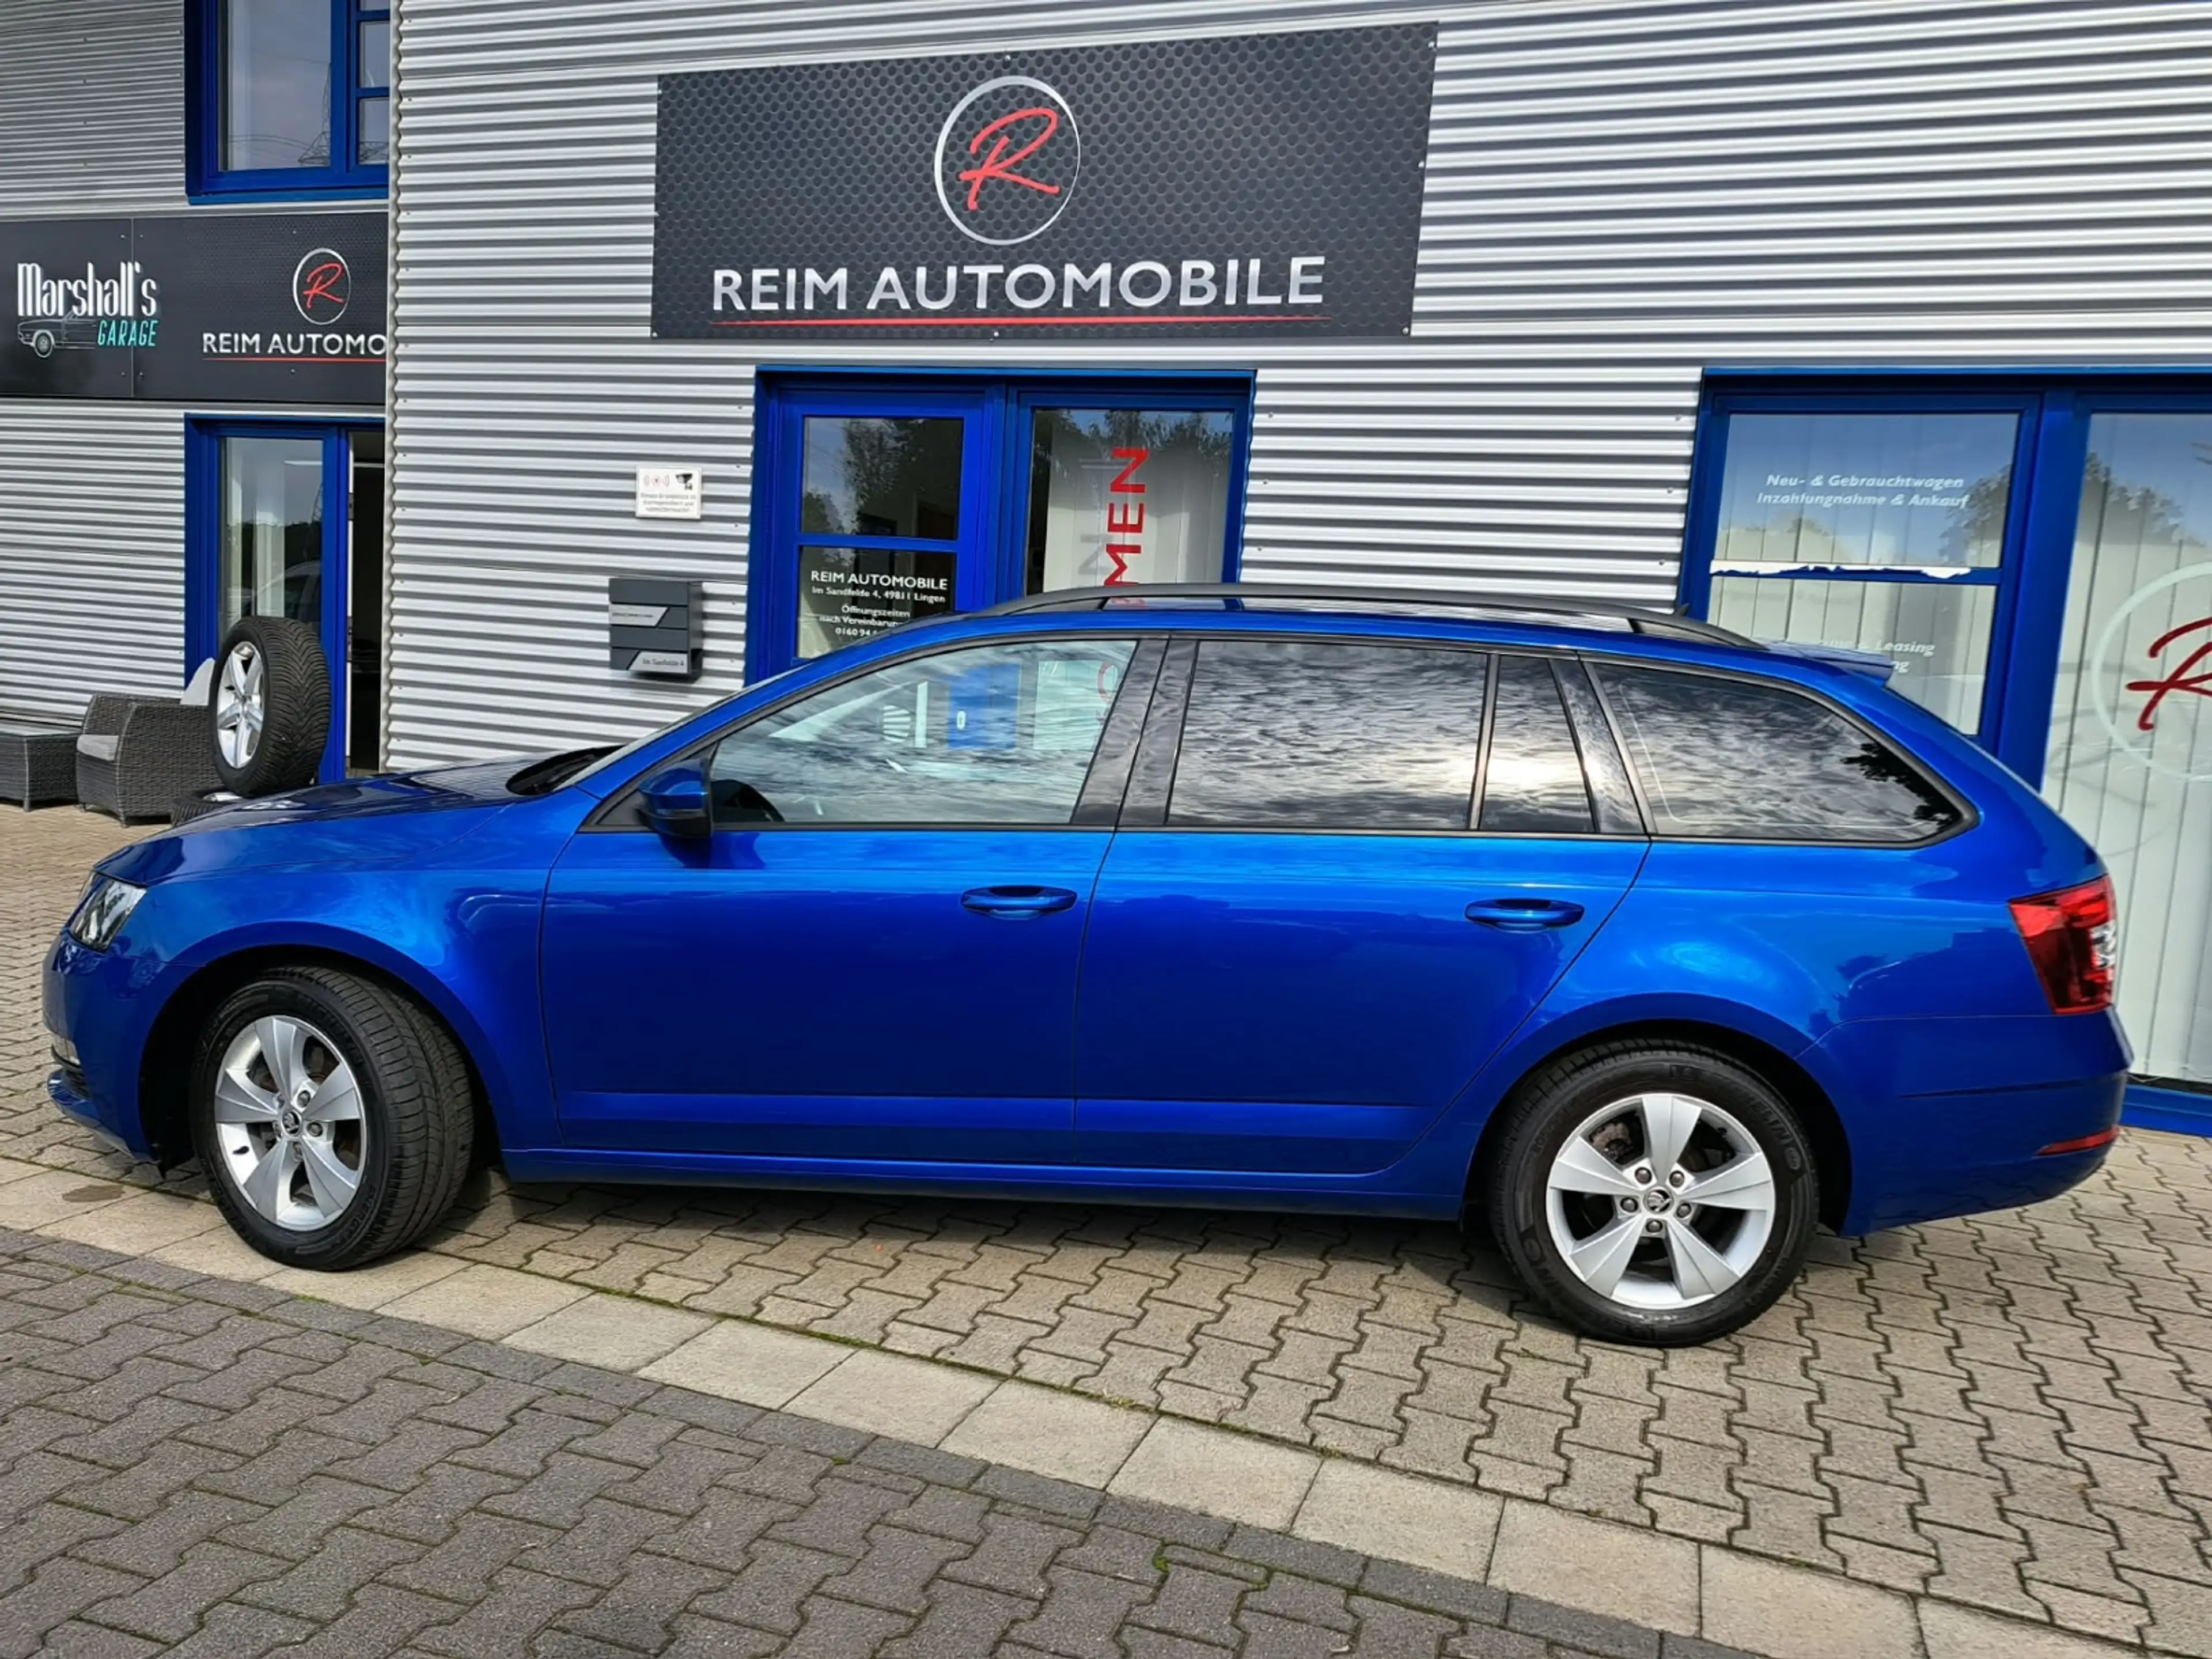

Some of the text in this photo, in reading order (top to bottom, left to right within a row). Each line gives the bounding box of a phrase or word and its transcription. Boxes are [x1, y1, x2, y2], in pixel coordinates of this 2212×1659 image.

[17, 261, 157, 317] Marshall's
[713, 256, 1326, 311] REIM AUTOMOBILE
[97, 319, 159, 347] GARAGE
[202, 332, 260, 354] REIM
[1766, 474, 1964, 491] Neu- & Gebrauchtwagen
[1757, 492, 1887, 508] Inzahlungnahme
[1908, 494, 1971, 509] Ankauf
[811, 570, 948, 590] REIM AUTOMOBILE
[914, 592, 946, 604] Lingen
[1874, 641, 1936, 657] Leasing
